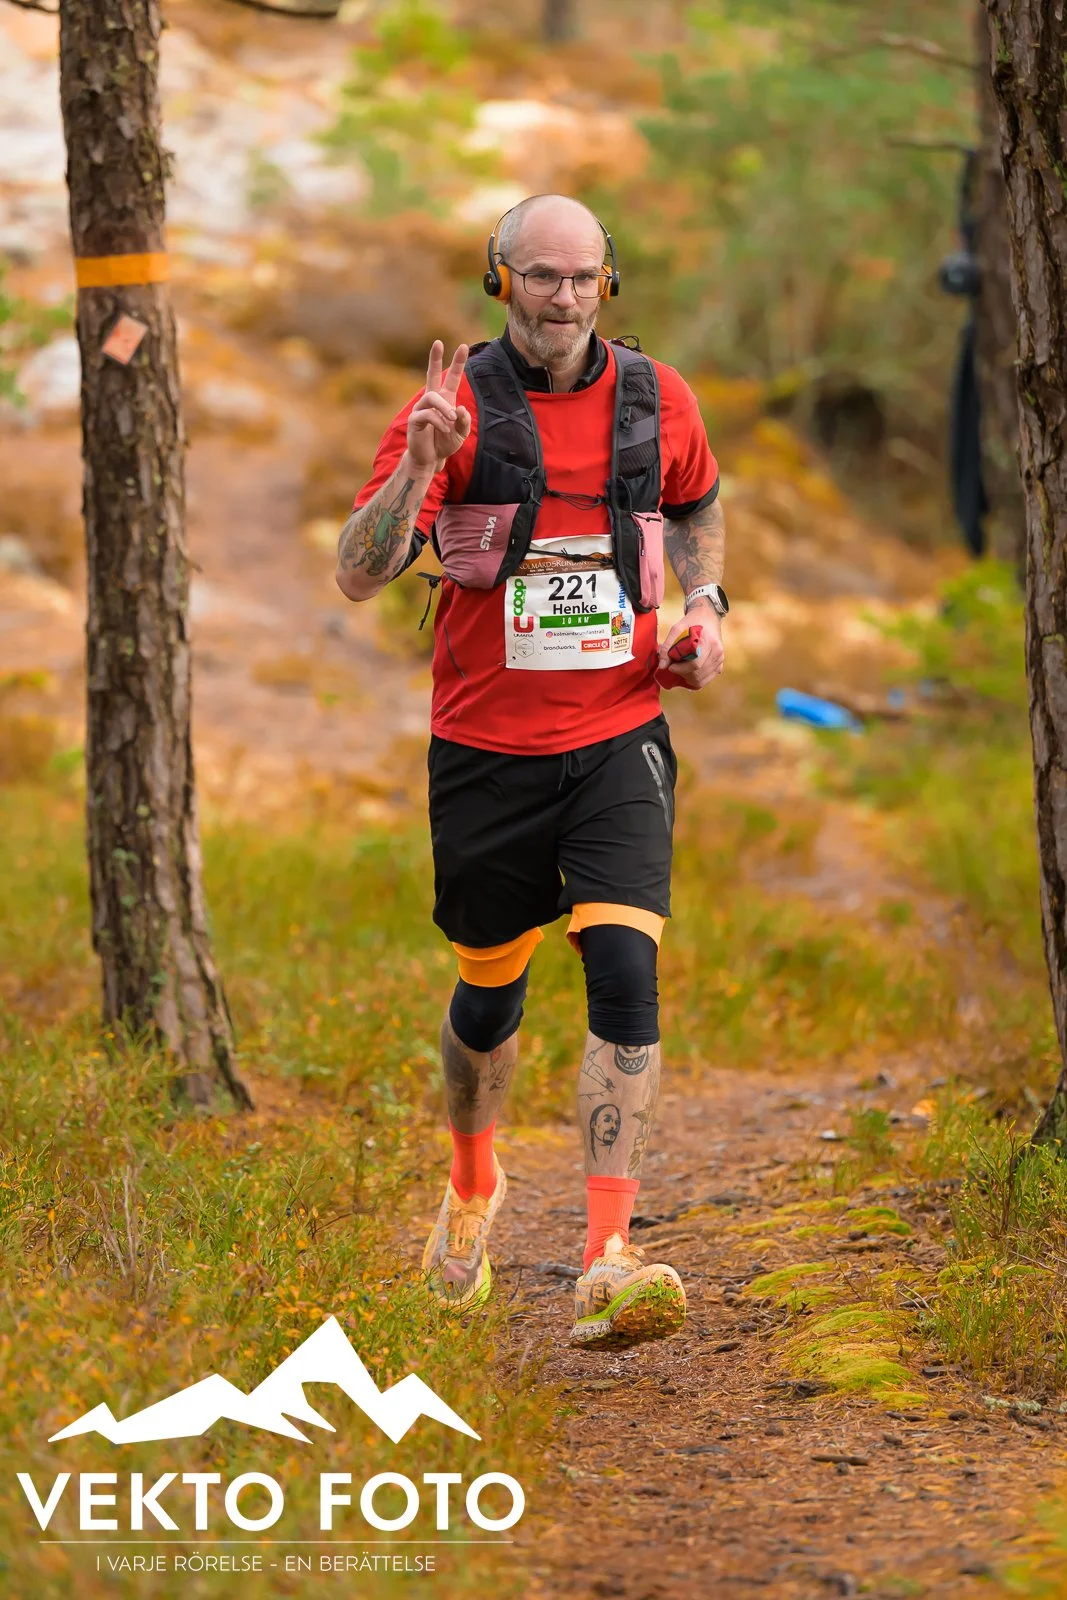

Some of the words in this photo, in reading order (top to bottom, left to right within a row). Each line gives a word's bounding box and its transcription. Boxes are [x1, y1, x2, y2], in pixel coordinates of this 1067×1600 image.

[480, 516, 497, 551] SILVA
[513, 578, 527, 616] coop
[548, 573, 597, 601] 221
[553, 602, 598, 615] Henke
[561, 617, 572, 625] 10
[577, 616, 591, 624] KM
